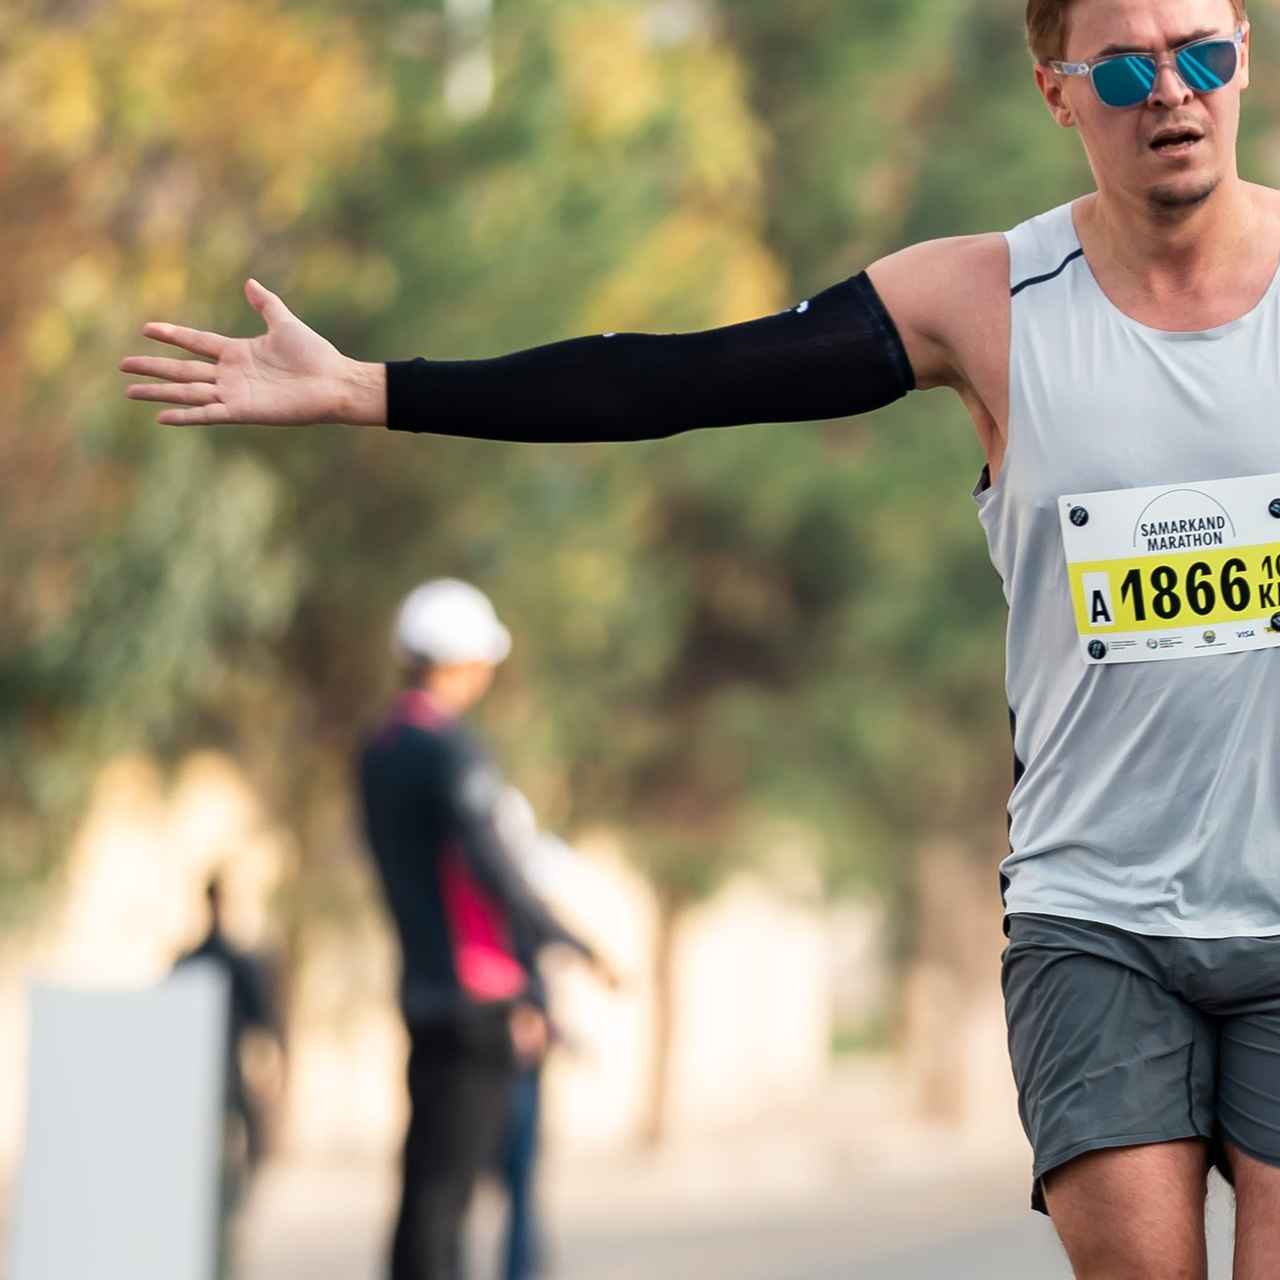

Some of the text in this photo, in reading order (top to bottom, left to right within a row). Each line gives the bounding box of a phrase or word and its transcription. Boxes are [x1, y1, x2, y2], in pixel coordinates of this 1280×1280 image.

[1140, 516, 1225, 537] SAMARKAND
[1147, 532, 1222, 551] MARATHON
[1091, 558, 1250, 623] A 1866
